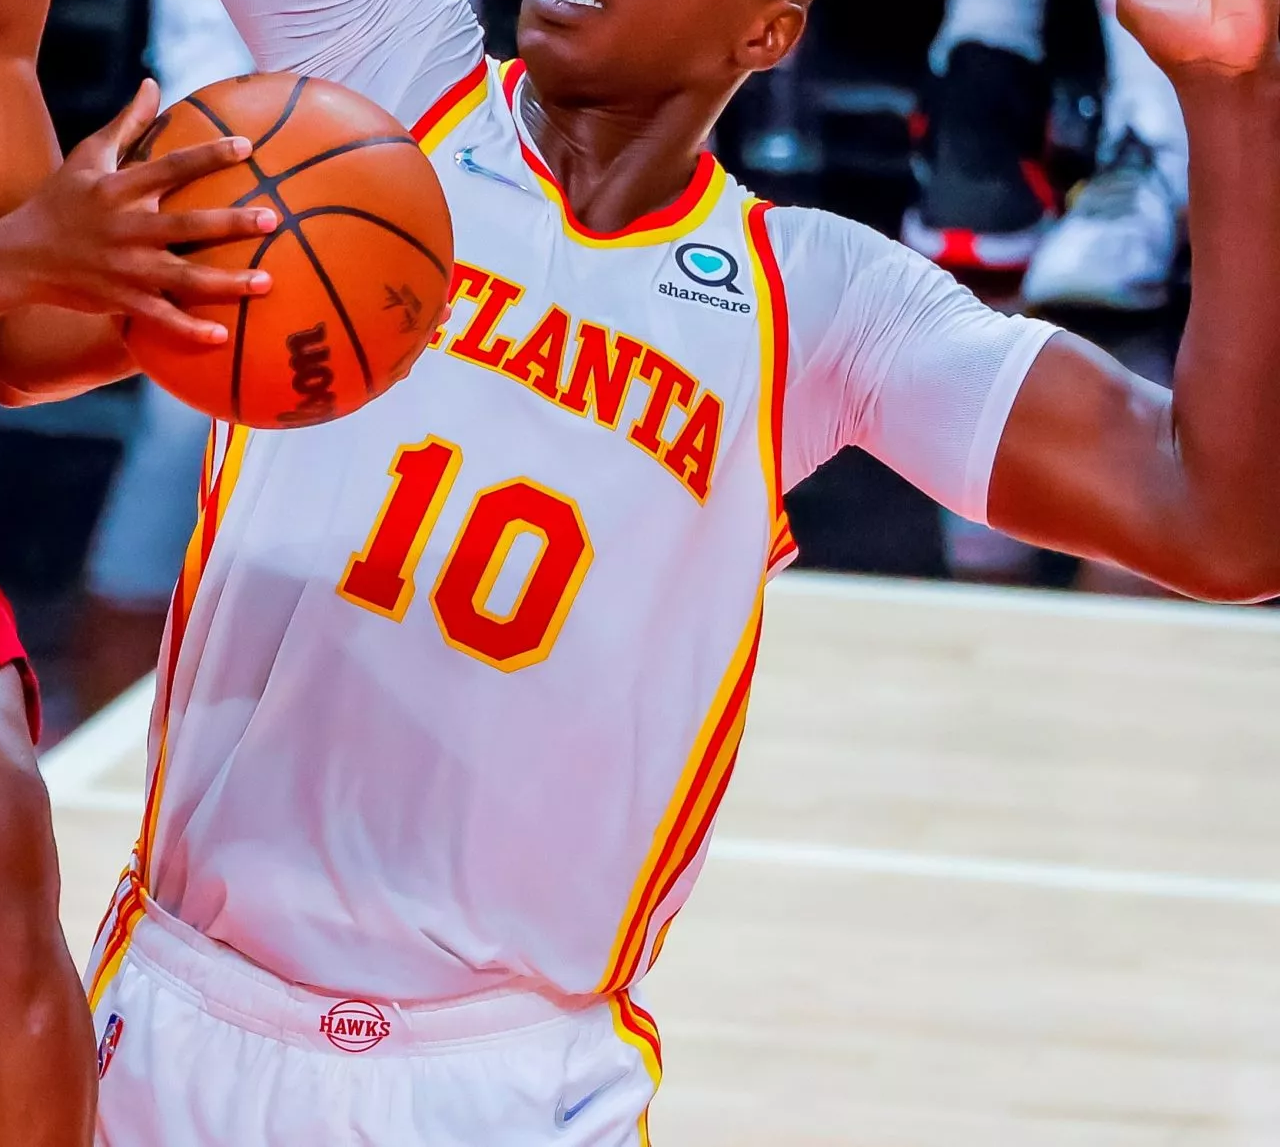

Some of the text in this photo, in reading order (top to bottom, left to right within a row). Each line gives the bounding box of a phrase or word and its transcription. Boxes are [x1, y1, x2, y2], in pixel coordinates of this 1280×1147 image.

[658, 282, 751, 314] sharecare
[426, 258, 724, 507] TLANTA
[336, 433, 595, 673] 10
[319, 1015, 391, 1037] HAWKS
